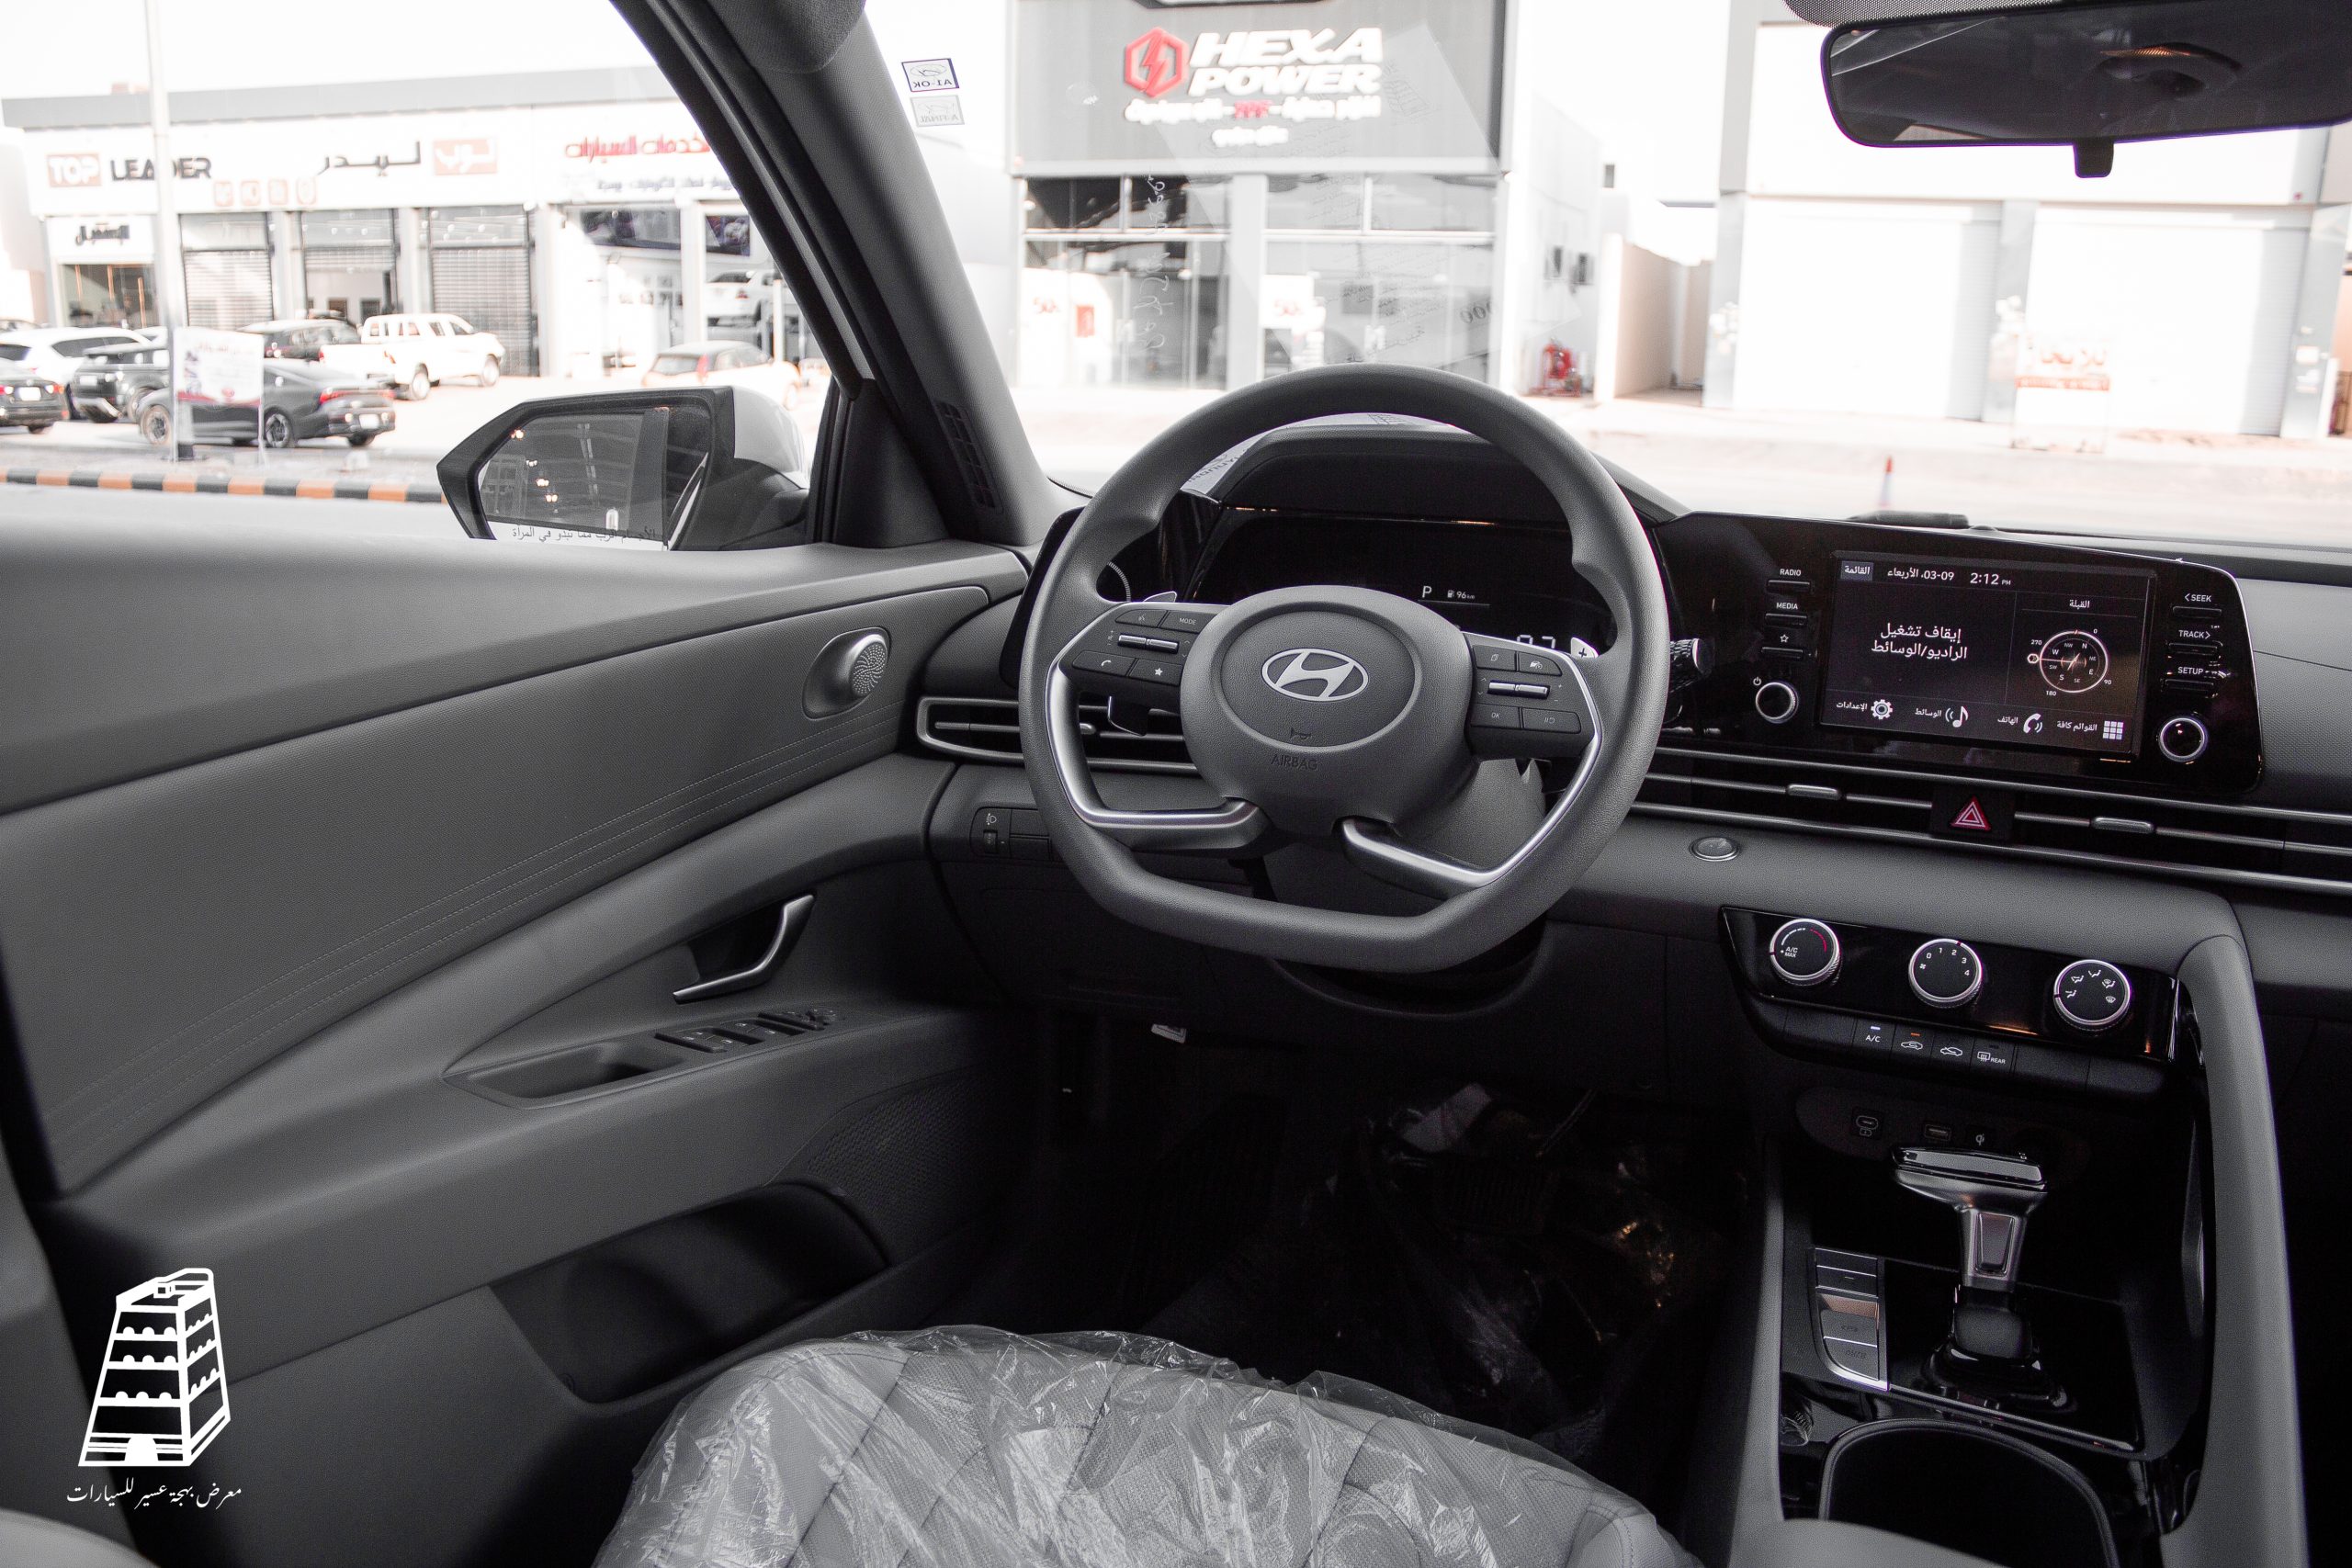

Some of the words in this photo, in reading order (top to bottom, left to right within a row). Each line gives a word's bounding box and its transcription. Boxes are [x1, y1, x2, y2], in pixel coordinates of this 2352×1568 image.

[1189, 28, 1383, 67] HEXA
[1187, 64, 1382, 96] POWER
[49, 153, 100, 186] TOP
[110, 157, 212, 181] LEAER
[1780, 569, 1802, 577] RADIO
[1844, 565, 1871, 575] القائمة
[1887, 567, 1918, 580] الأربعاء
[1970, 572, 1999, 585] 2:12
[1422, 585, 1432, 598] P
[2190, 594, 2212, 603] SEEK
[2069, 599, 2090, 610] القبلة
[1179, 617, 1196, 626] MODE
[1881, 622, 1922, 639] تشغيل
[1925, 626, 1962, 644] إيقاف
[2178, 629, 2204, 638] TRACK
[1836, 701, 1868, 711] الإعدادات
[1915, 708, 1942, 718] الوسائط
[1997, 716, 2018, 725] الهاتف
[1271, 754, 1317, 770] AIRBAG
[1865, 1034, 1881, 1043] A/C
